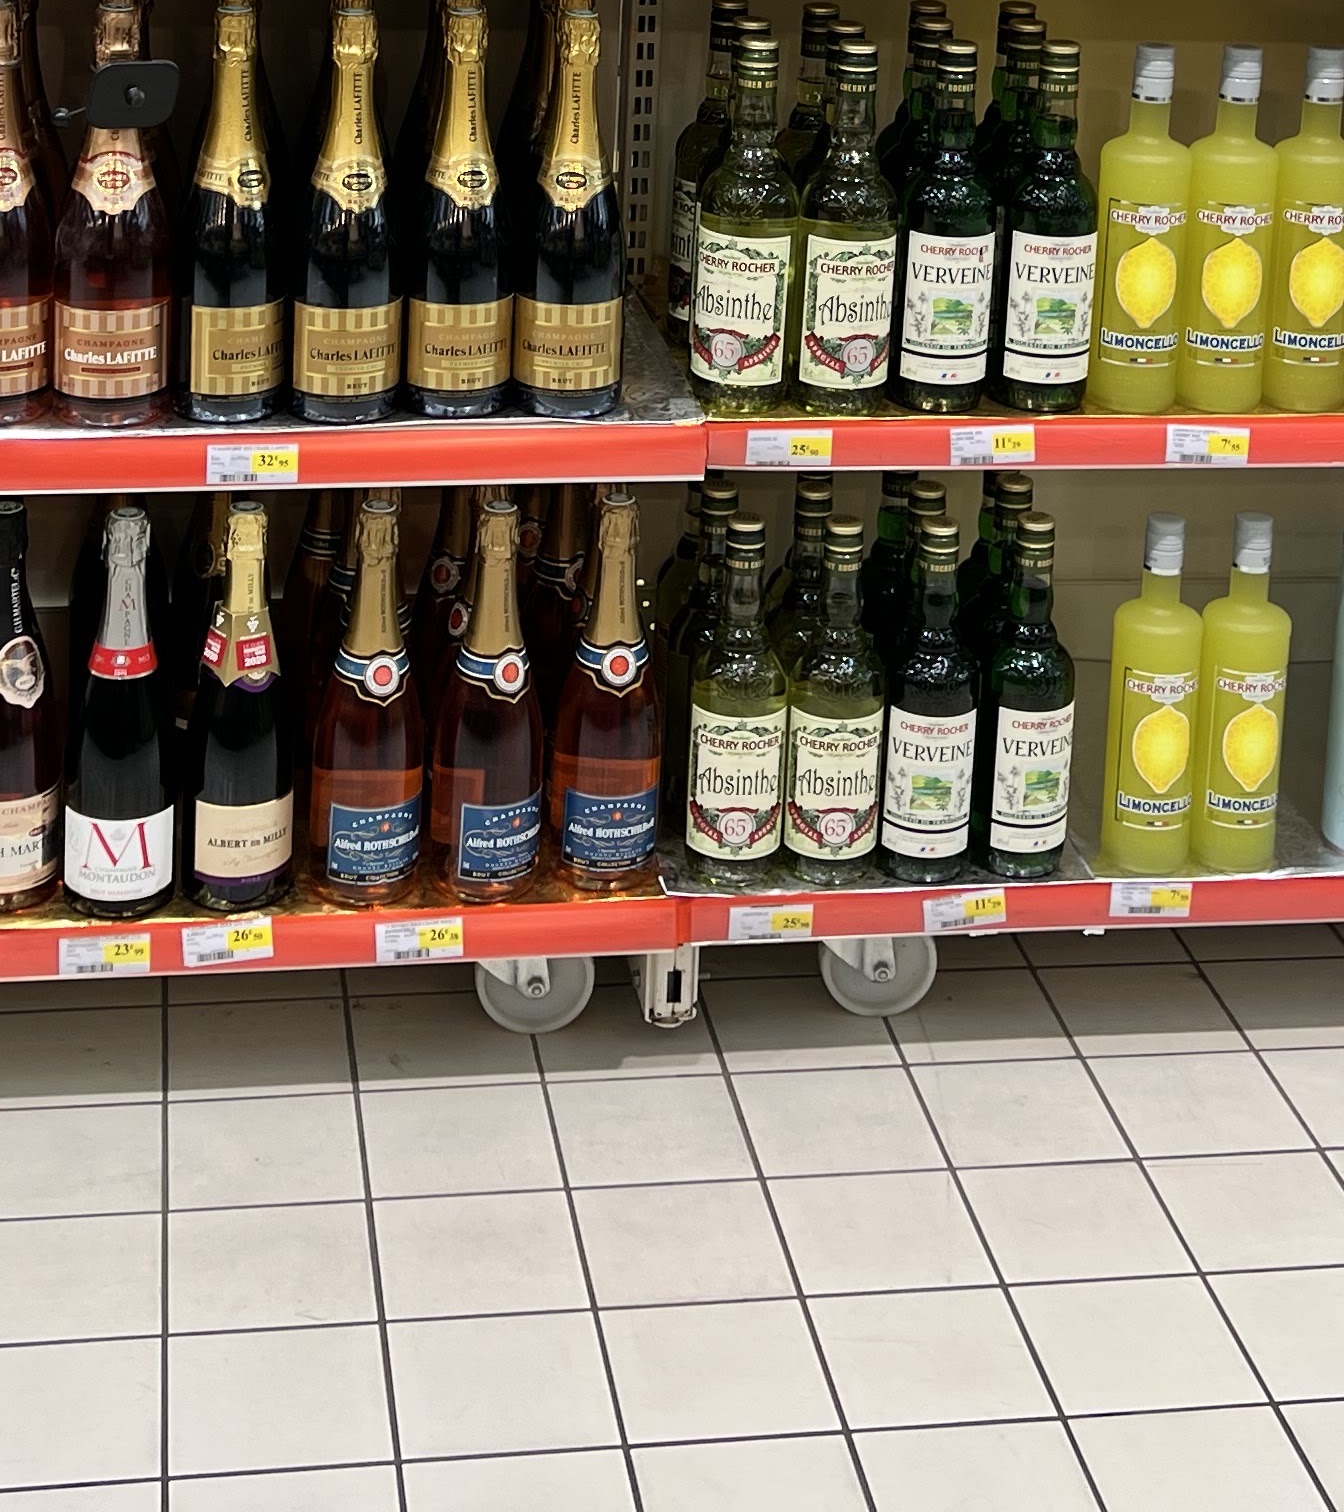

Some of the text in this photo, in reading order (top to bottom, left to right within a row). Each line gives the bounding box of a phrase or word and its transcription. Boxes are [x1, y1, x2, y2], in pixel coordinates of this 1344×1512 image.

[912, 264, 992, 285] VERVEINE
[1015, 263, 1094, 283] VERVEINE
[696, 285, 773, 324] Absinthe
[714, 340, 735, 358] 65
[1101, 328, 1177, 351] LIMONCELLO
[1187, 327, 1264, 352] LIMONCELLO
[1, 341, 46, 361] LAFITTE
[107, 347, 157, 364] LAFITTE
[552, 377, 573, 385] BRUT
[893, 736, 972, 763] VERVEINE
[699, 768, 778, 796] Absinthe
[208, 828, 287, 848] ALBERT MILLY
[568, 823, 594, 836] Alfred
[725, 819, 746, 837] 65
[334, 838, 361, 850] Alfred
[79, 867, 156, 885] MONTAUDON
